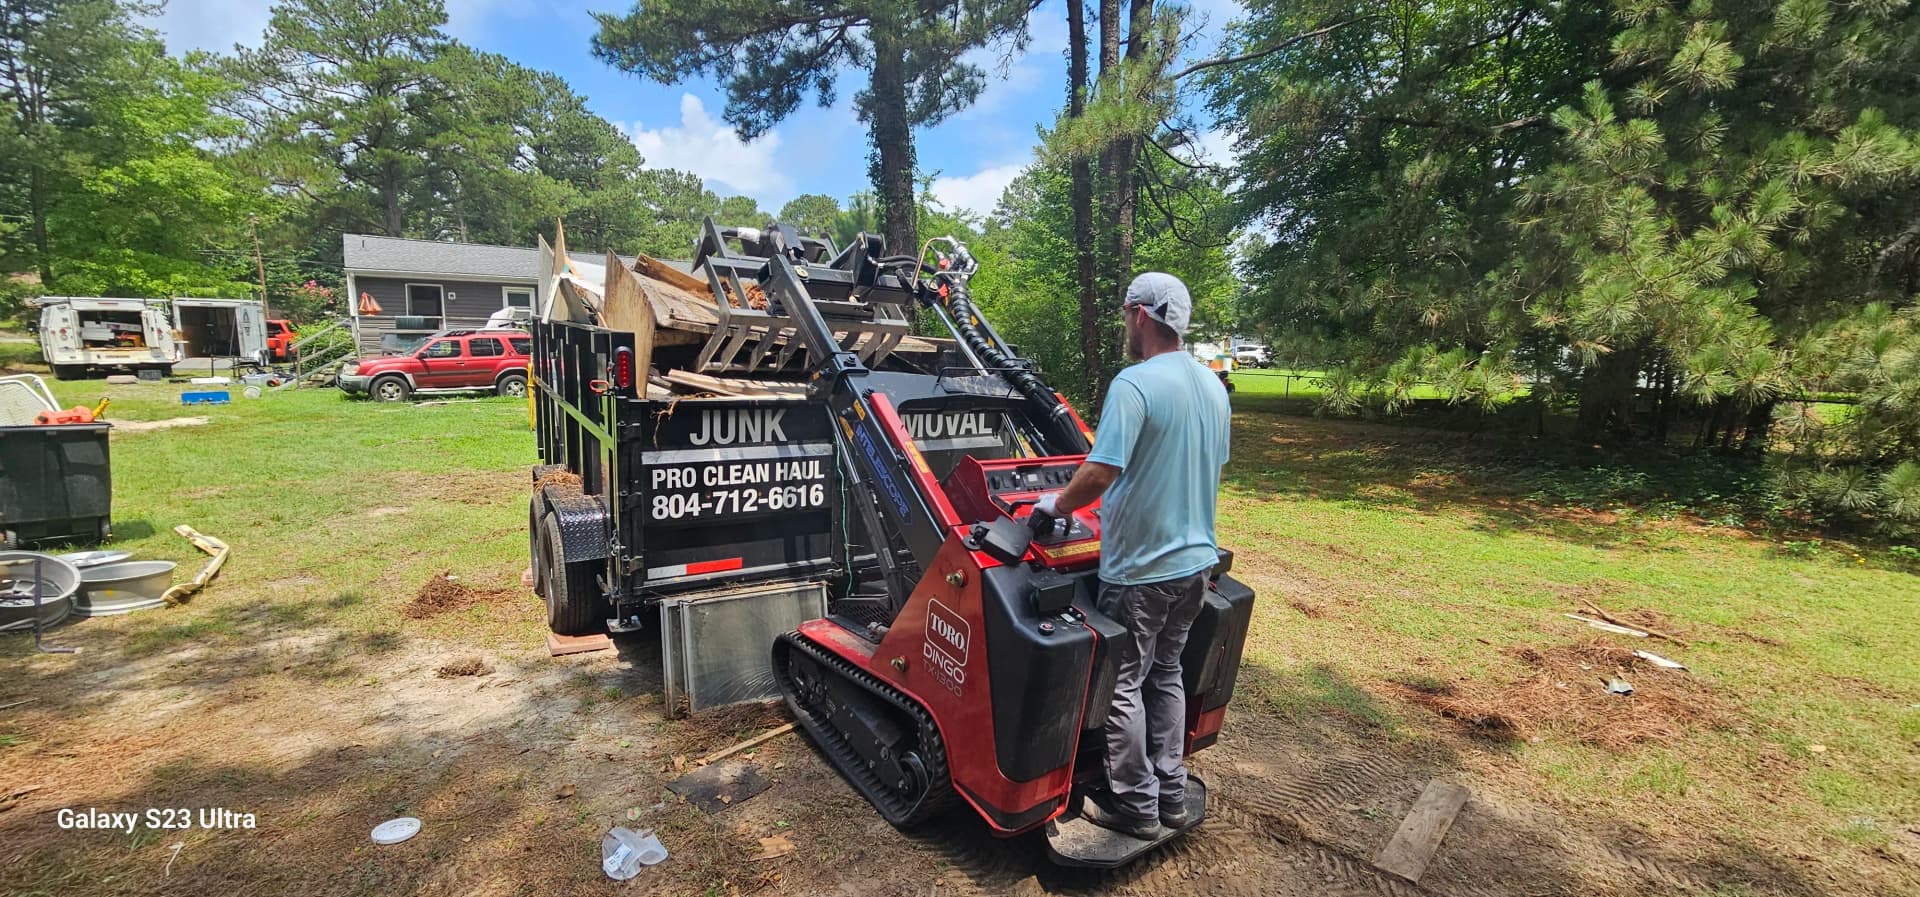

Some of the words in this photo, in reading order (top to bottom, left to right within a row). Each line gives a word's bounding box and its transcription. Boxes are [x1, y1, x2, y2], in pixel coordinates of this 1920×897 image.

[689, 409, 788, 446] JUNK
[652, 467, 697, 490] PRO
[703, 463, 770, 487] CLEAN
[775, 460, 825, 482] HAUL
[651, 483, 824, 520] 804-712-6616
[930, 612, 966, 652] TORO
[923, 641, 965, 684] DINGO
